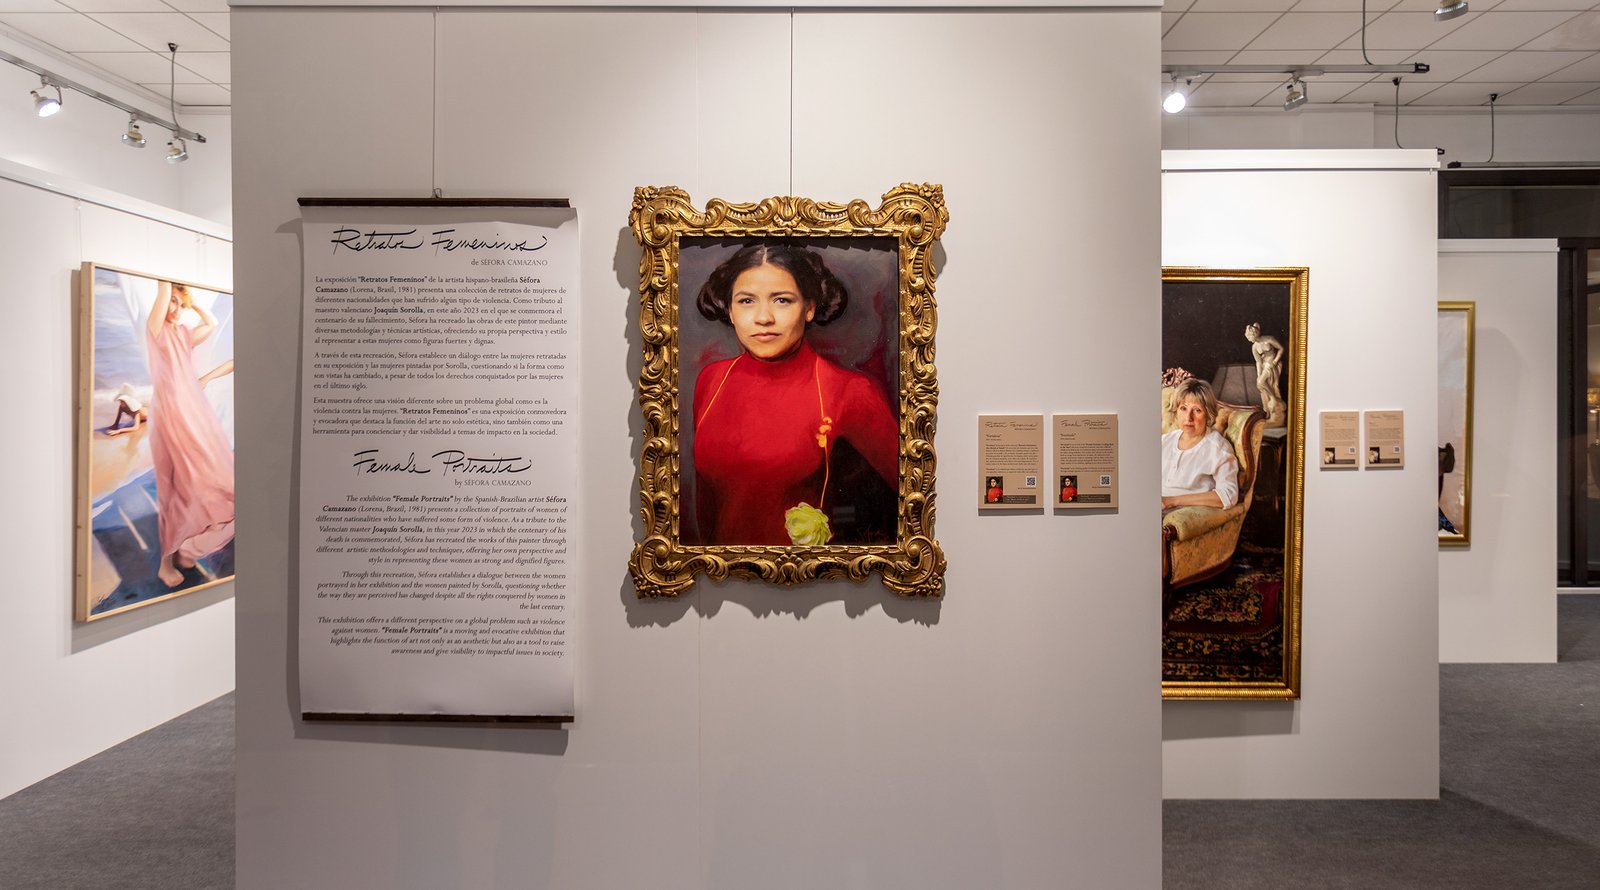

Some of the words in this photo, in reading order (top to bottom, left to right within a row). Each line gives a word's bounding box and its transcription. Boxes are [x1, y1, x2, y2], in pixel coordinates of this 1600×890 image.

[331, 226, 424, 255] Retratos
[431, 229, 548, 256] Femeninos
[324, 276, 357, 284] exposición
[374, 306, 398, 315] Joaquín
[340, 326, 381, 335] metodologías
[487, 327, 507, 336] propia
[509, 328, 543, 336] perspectiva
[423, 337, 444, 346] figuras
[493, 408, 526, 417] exposición
[487, 428, 512, 437] impacto
[353, 450, 430, 476] Female
[432, 450, 532, 476] Portraits
[455, 479, 463, 488] by
[454, 496, 462, 504] by
[546, 496, 566, 504] Séfora
[316, 515, 342, 524] different
[414, 516, 438, 524] suffered
[458, 516, 473, 524] form
[475, 516, 482, 524] of
[404, 536, 424, 545] Séfora
[498, 536, 505, 545] of
[519, 537, 541, 546] painter
[542, 537, 566, 546] through
[343, 571, 369, 580] Through
[418, 572, 437, 580] Séfora
[477, 572, 503, 581] dialogue
[332, 626, 353, 635] against
[455, 627, 478, 636] moving
